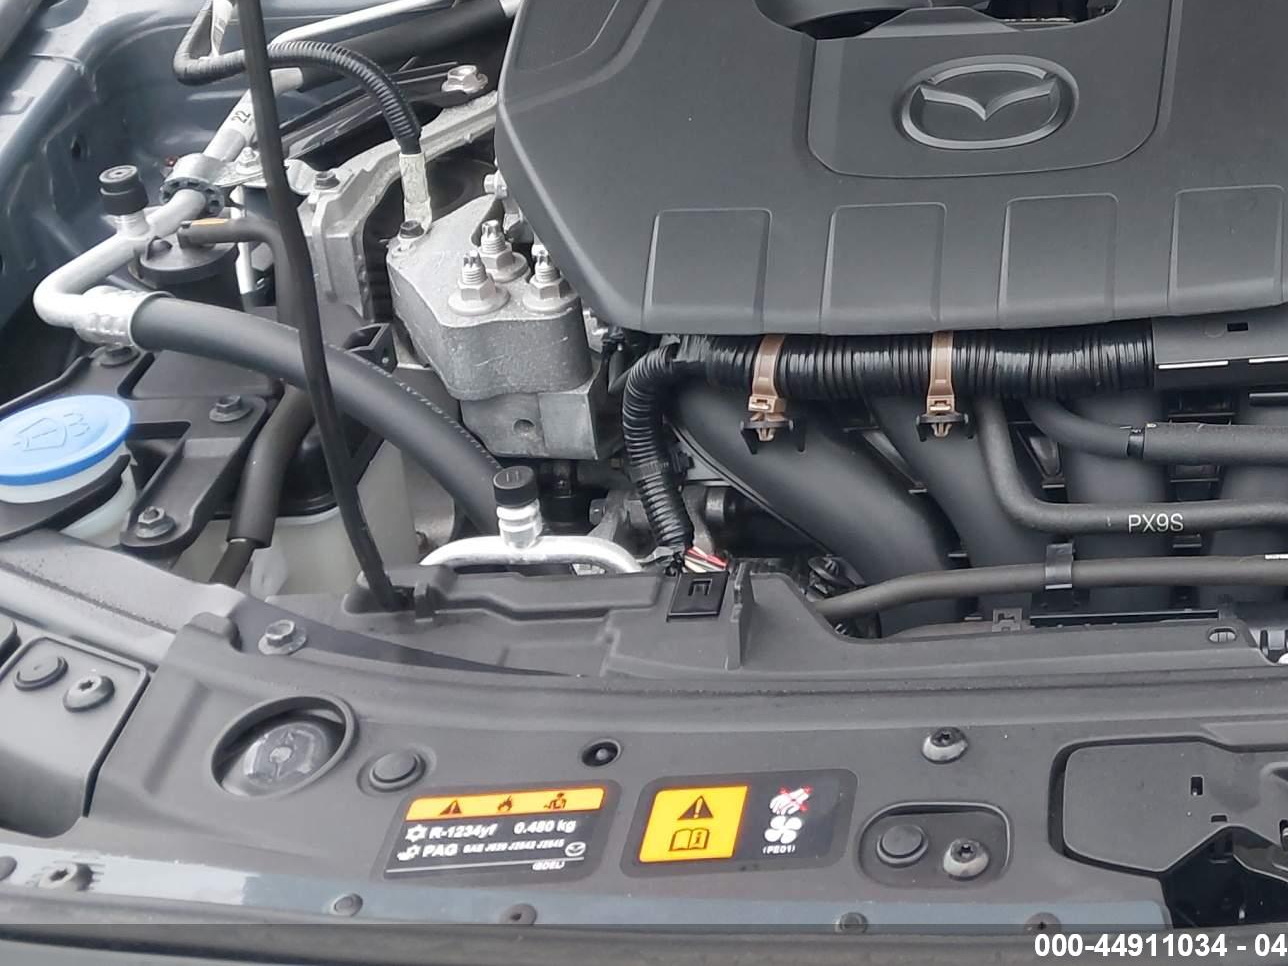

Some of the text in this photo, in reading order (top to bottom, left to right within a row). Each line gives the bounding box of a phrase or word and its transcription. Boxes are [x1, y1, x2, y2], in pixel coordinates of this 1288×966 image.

[1128, 512, 1184, 533] PX9S
[429, 819, 577, 839] R-1234yf 0.480 kg
[422, 843, 458, 857] PAG
[762, 844, 796, 854] (PE01)
